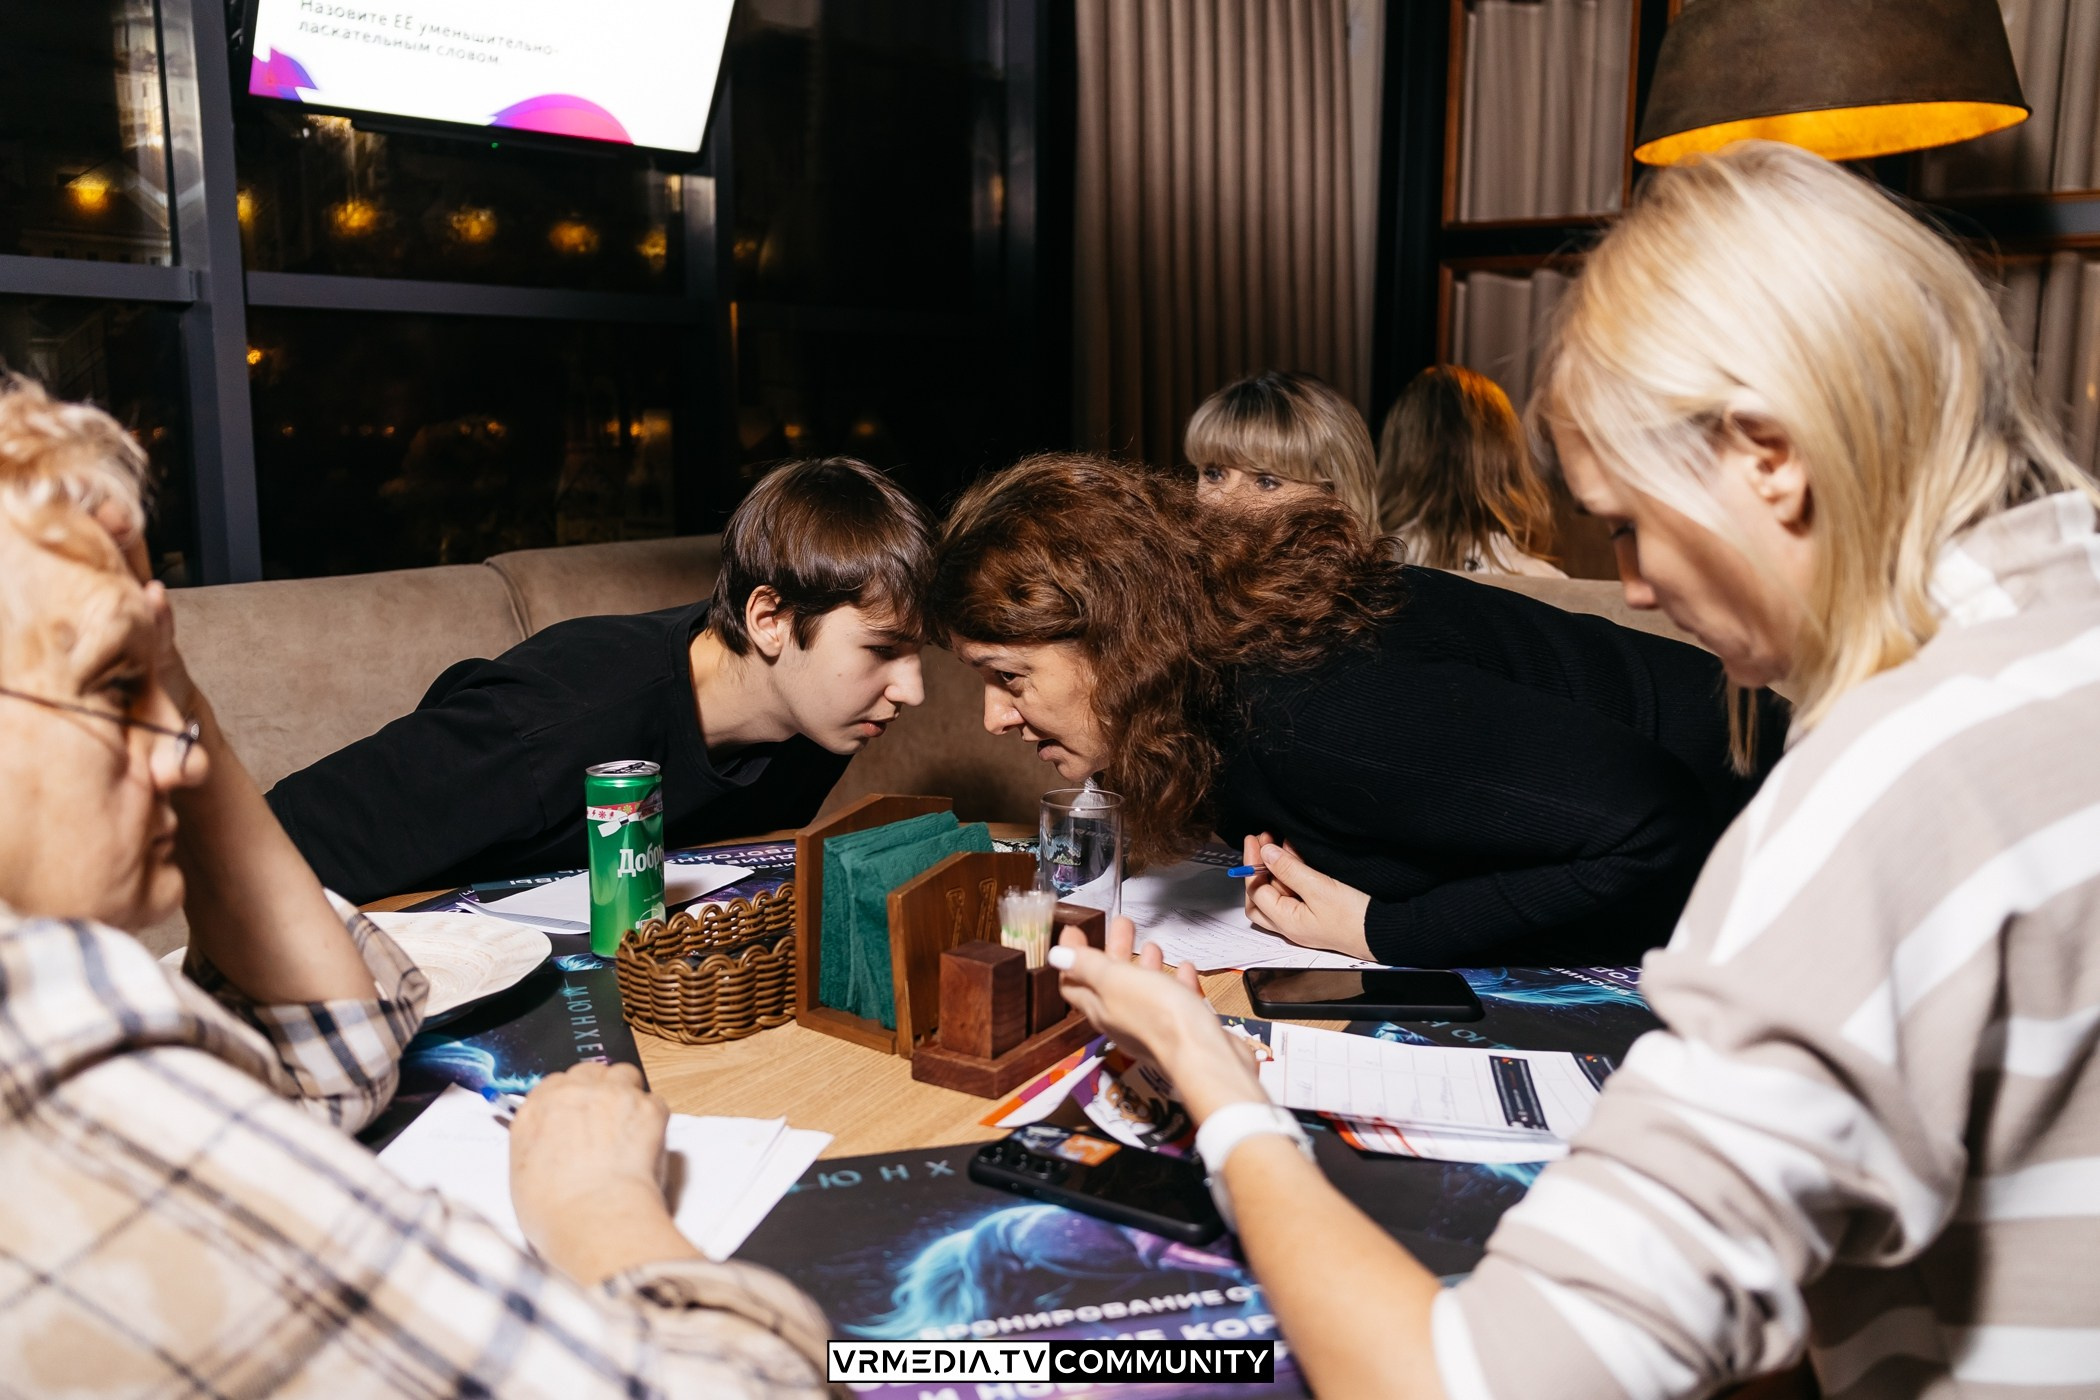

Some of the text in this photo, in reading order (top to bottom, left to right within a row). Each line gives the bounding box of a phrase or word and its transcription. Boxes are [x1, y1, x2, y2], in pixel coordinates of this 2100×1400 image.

[300, 0, 388, 26] Назовите
[299, 21, 430, 51] ласкательным
[920, 1288, 1224, 1340] БРОНИРОВАНИЕ
